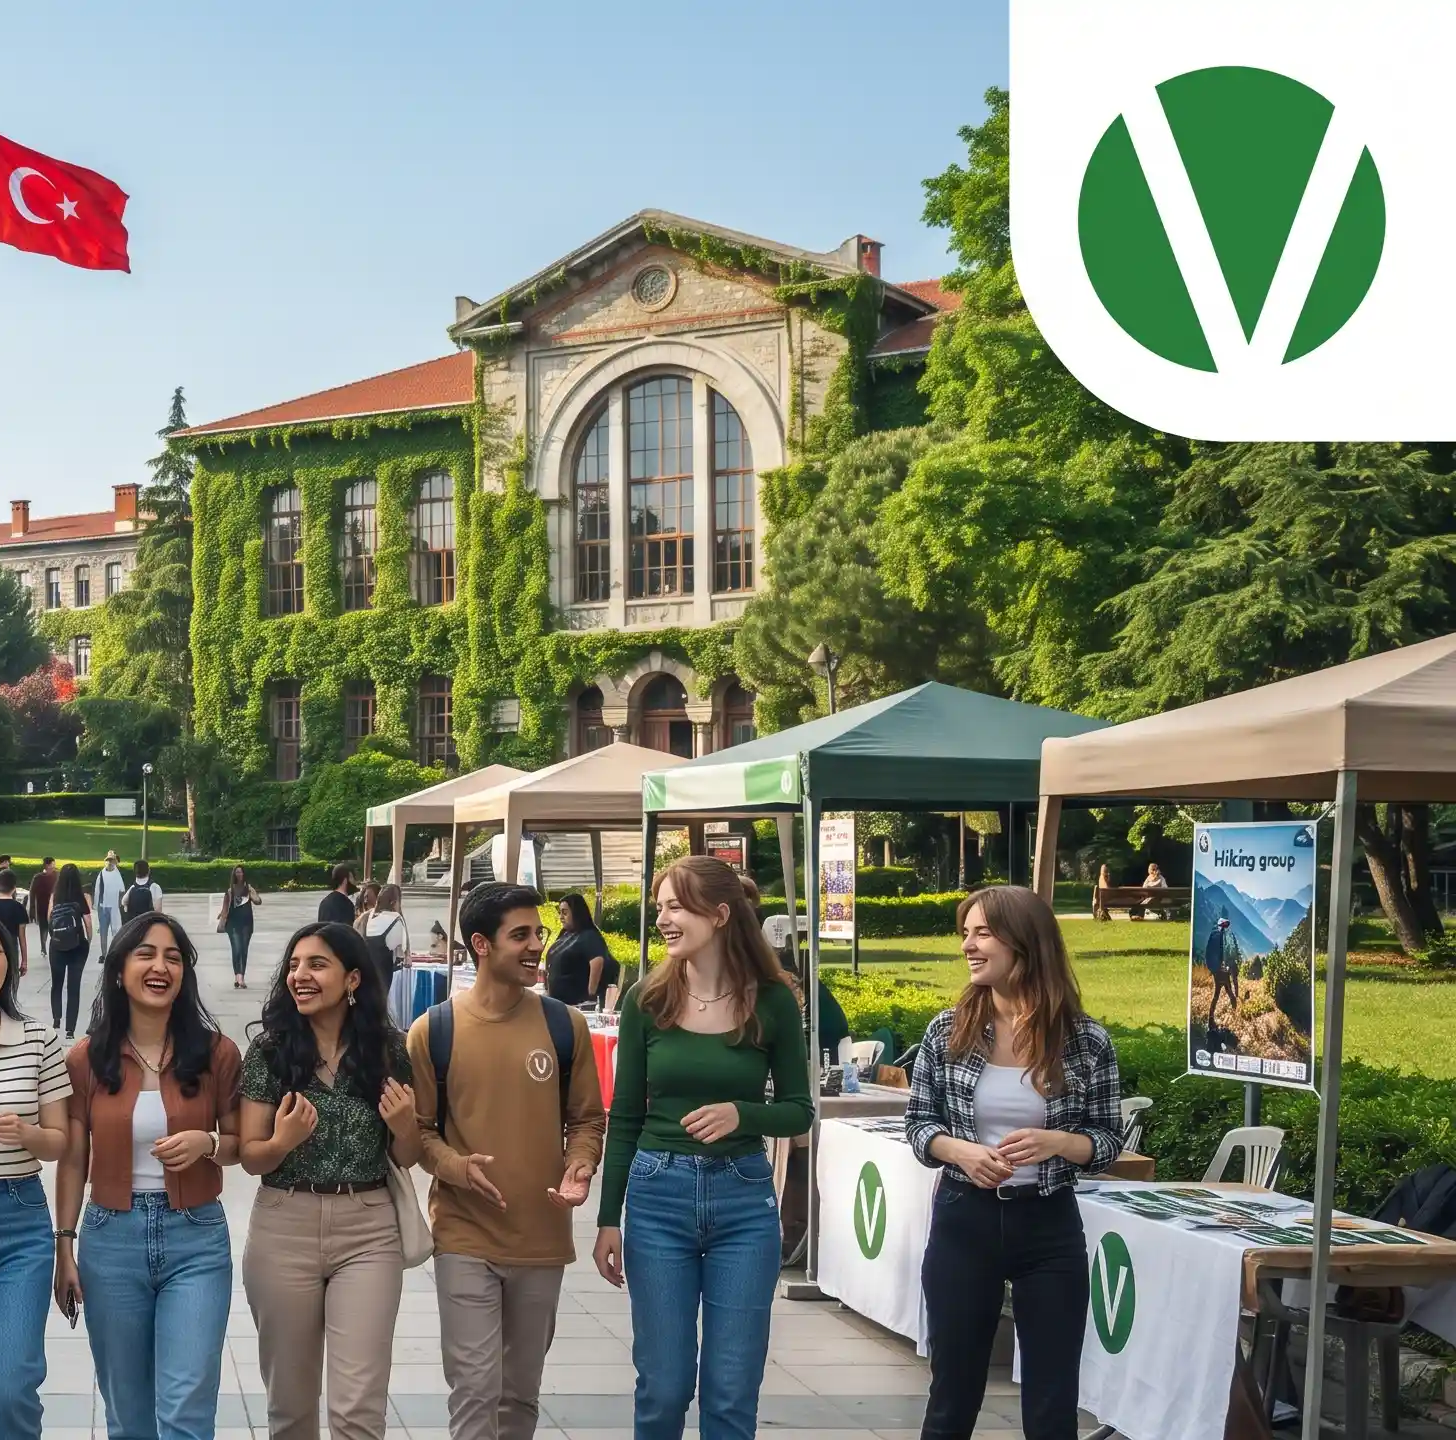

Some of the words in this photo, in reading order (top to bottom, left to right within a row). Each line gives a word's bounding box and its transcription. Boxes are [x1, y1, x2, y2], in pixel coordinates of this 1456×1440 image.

[1214, 848, 1256, 872] Hiking
[1259, 854, 1296, 872] group
[849, 1178, 883, 1249] V
[1096, 1241, 1129, 1338] V
